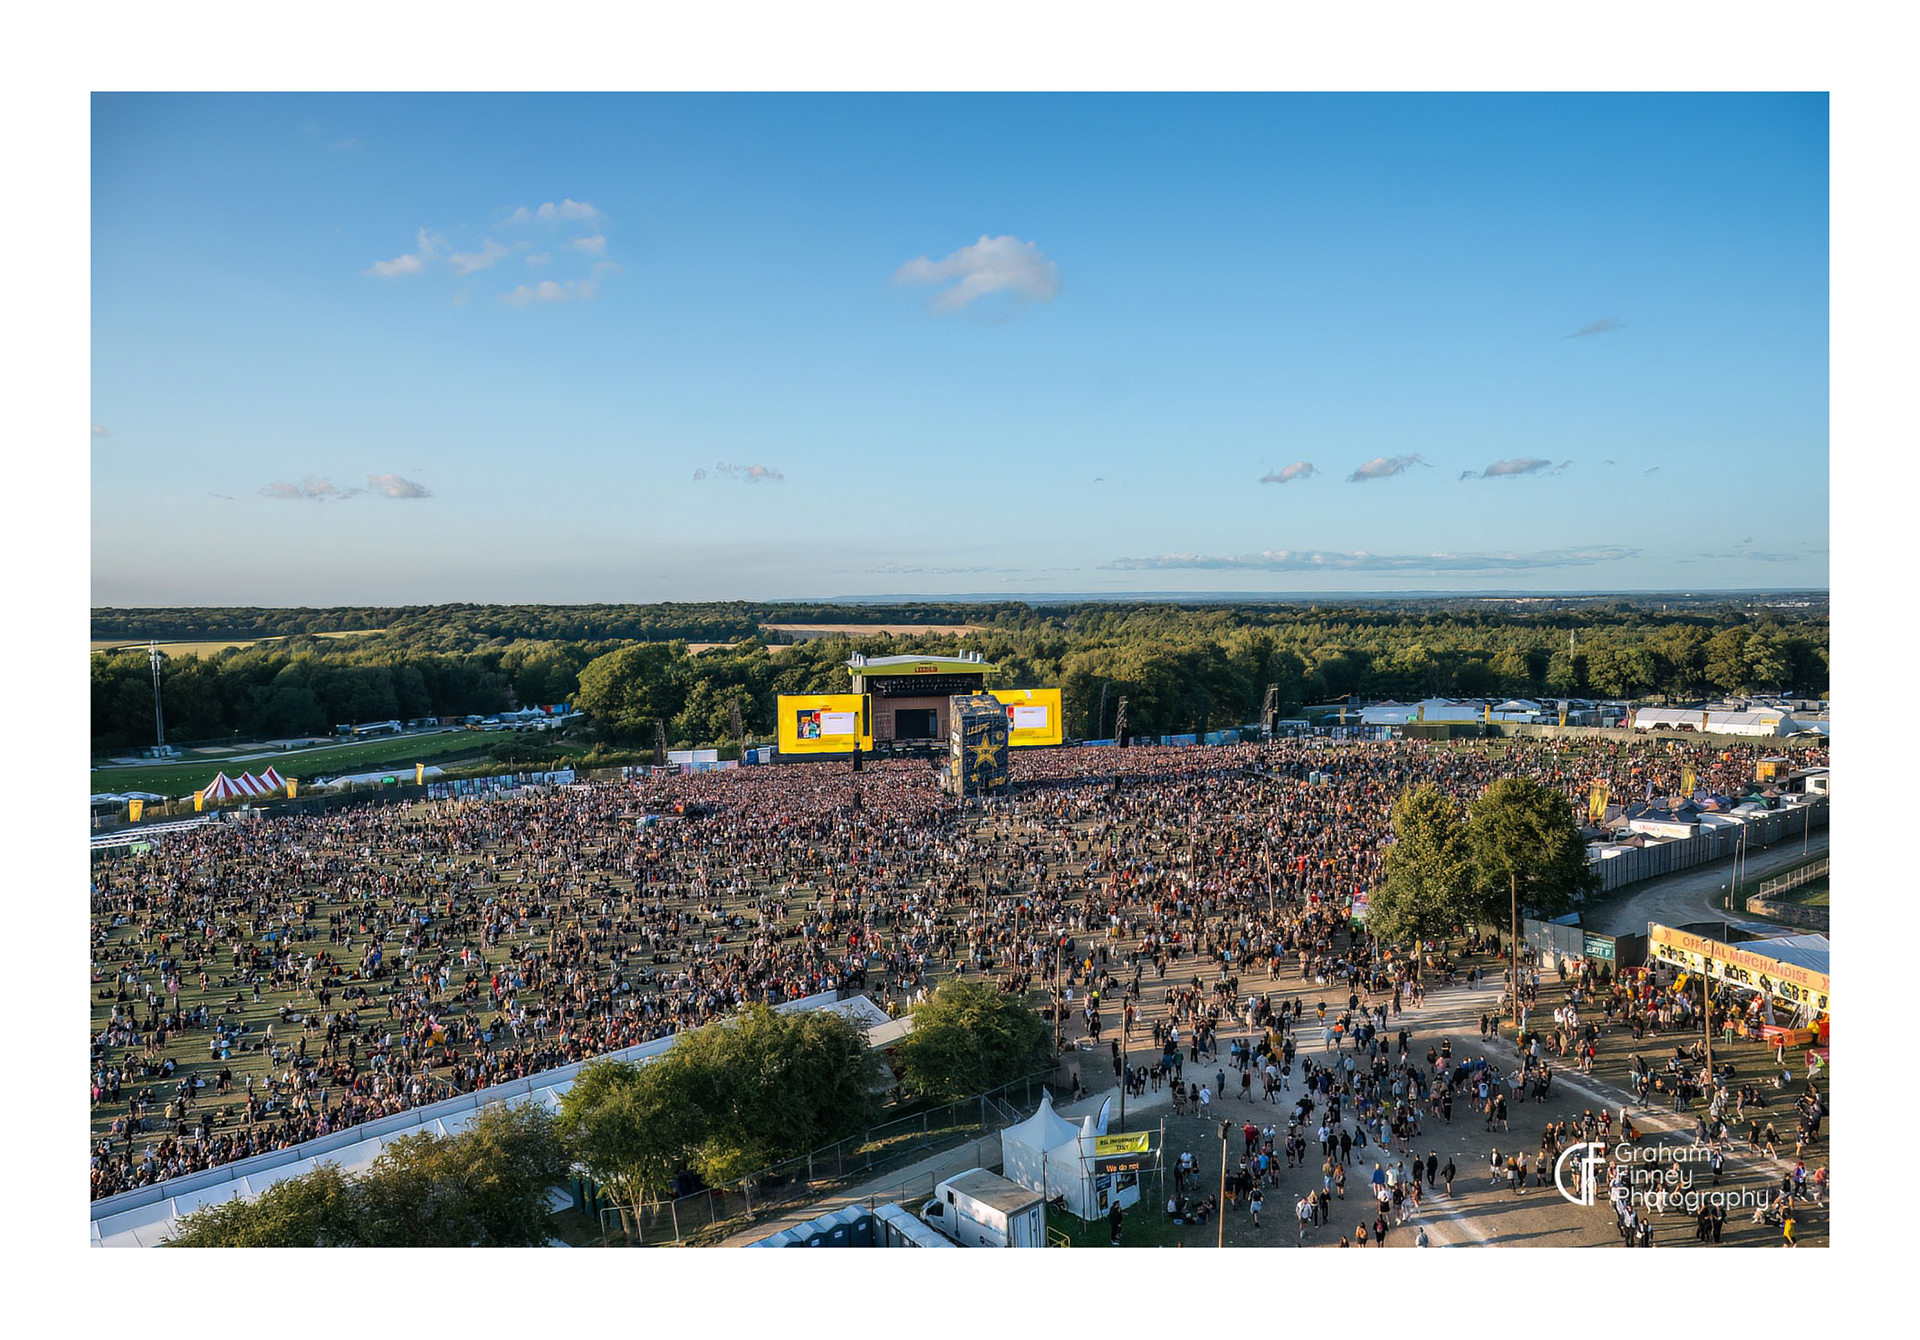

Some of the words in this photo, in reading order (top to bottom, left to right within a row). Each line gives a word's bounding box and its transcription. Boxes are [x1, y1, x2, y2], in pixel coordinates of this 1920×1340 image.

[1586, 945, 1603, 956] EXIT
[1605, 949, 1611, 957] F
[1682, 936, 1727, 958] OFFICAL
[1729, 950, 1808, 983] MERCHANDISE
[1106, 1164, 1117, 1172] We
[1119, 1163, 1127, 1171] do
[1129, 1162, 1139, 1171] not
